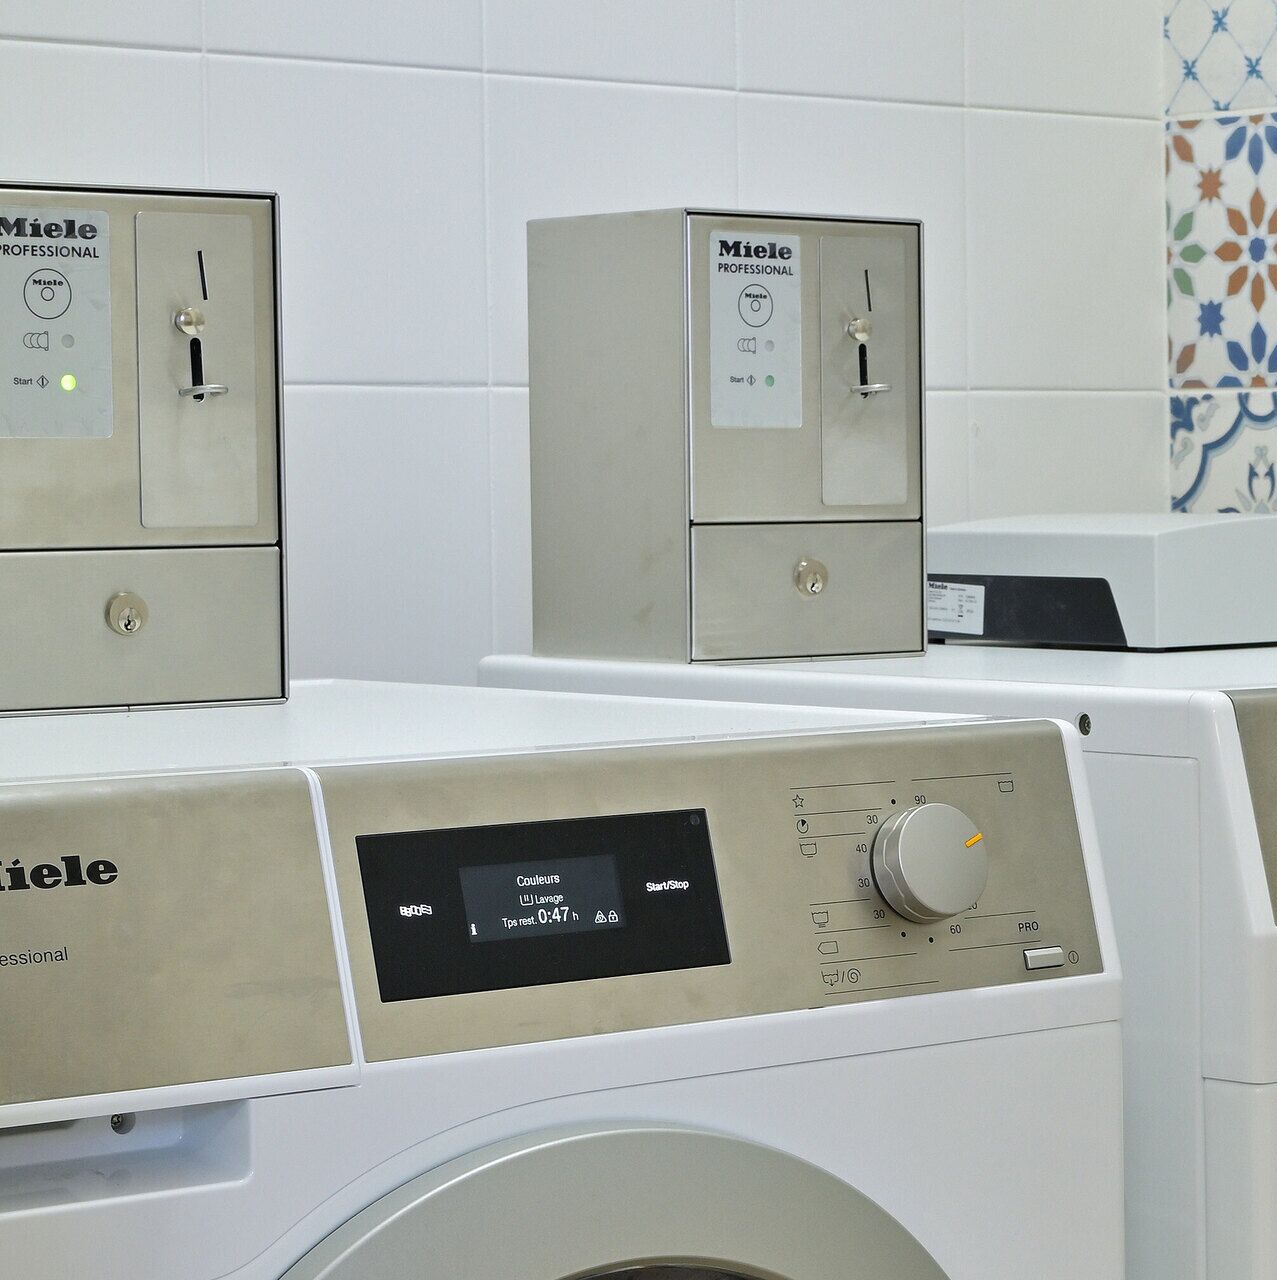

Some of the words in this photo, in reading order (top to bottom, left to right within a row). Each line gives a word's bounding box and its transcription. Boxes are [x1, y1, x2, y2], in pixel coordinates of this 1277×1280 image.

[0, 217, 98, 240] Miele
[0, 244, 99, 258] ROFESSIONAL
[718, 239, 793, 260] Miele
[718, 263, 794, 276] PROFESSIONAL
[13, 377, 33, 385] Start
[914, 795, 927, 805] 90
[866, 815, 878, 825] 30
[856, 844, 868, 853] 40
[0, 856, 118, 891] iele
[517, 874, 560, 886] Couleurs
[646, 880, 689, 891] Start/Stop
[858, 878, 871, 888] 30
[534, 894, 564, 905] Lavage
[501, 917, 519, 930] Tps
[519, 917, 538, 926] rest.
[537, 906, 570, 925] 0:47
[572, 911, 579, 921] h
[873, 909, 885, 919] 30
[949, 924, 962, 935] 60
[1018, 921, 1039, 932] PRO
